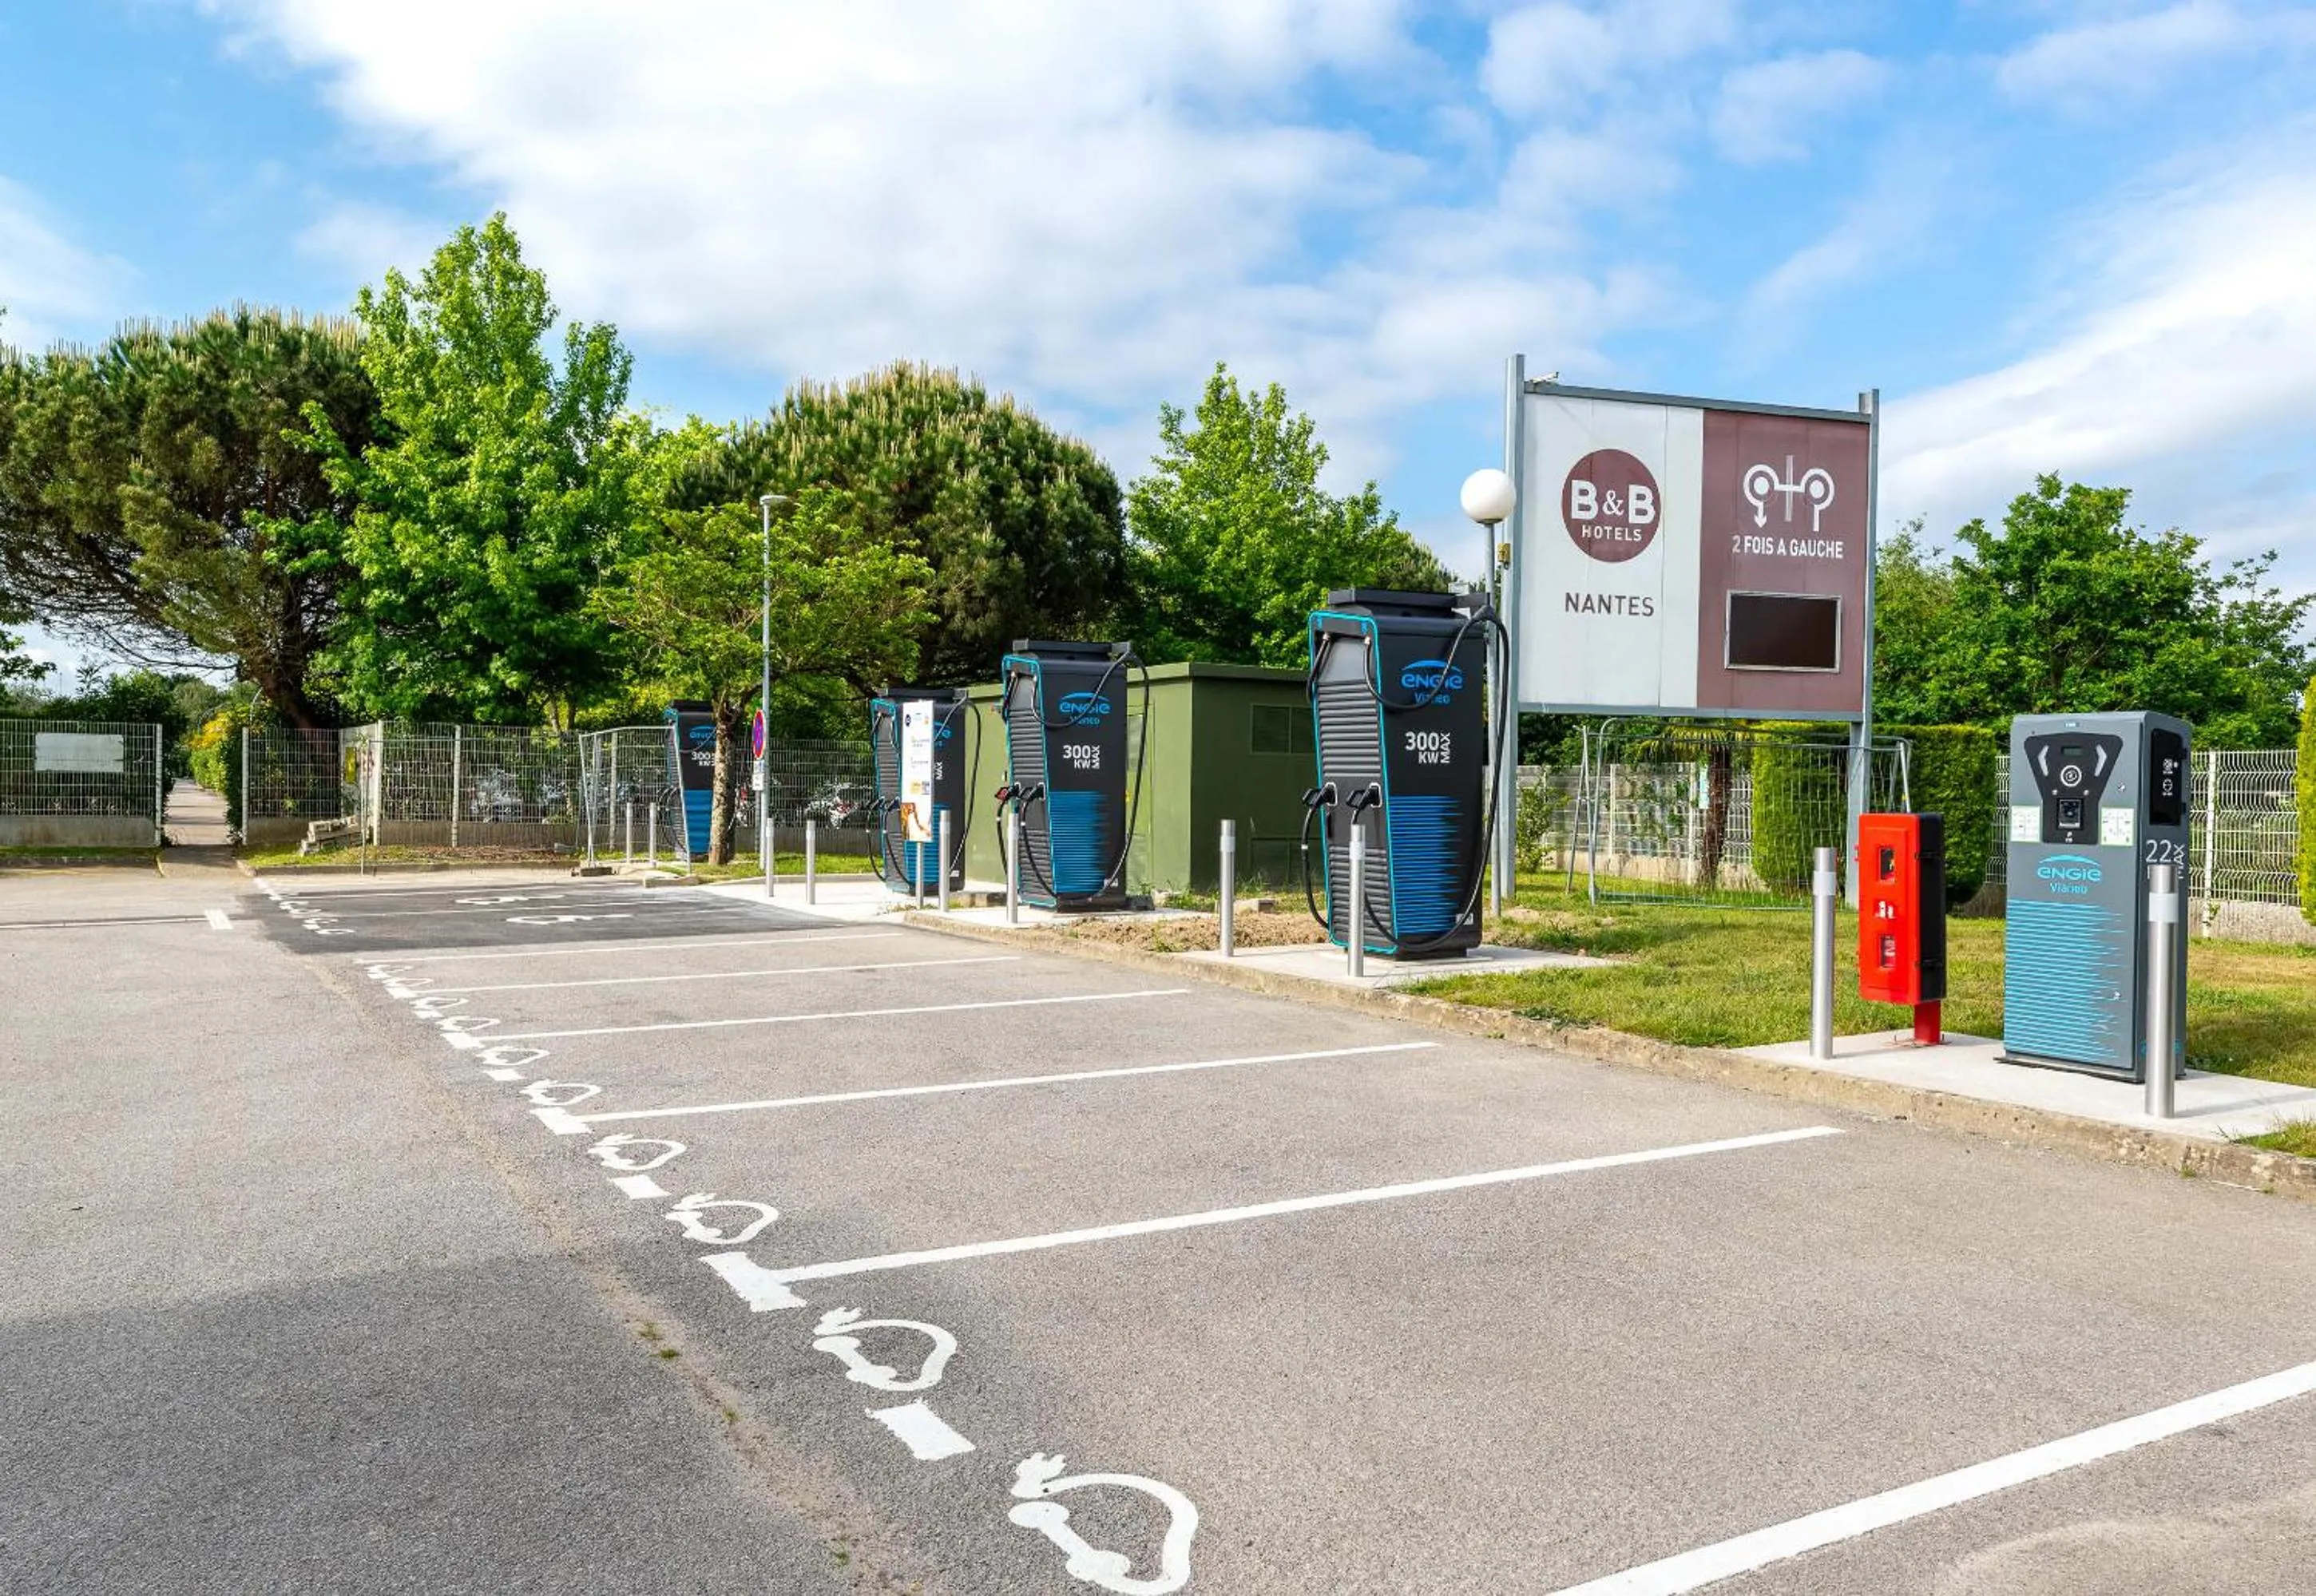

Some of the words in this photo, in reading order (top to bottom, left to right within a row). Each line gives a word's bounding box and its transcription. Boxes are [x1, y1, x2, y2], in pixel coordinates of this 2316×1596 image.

[1571, 479, 1656, 524] B&B
[1581, 525, 1642, 541] HOTELS
[1731, 535, 1741, 553] 2
[1743, 536, 1774, 555] FOIS
[1777, 537, 1787, 556] A
[1790, 538, 1844, 559] GAUCHE
[1565, 592, 1655, 616] NANTES
[1406, 731, 1439, 750] 300
[1440, 732, 1450, 763] MAX
[1063, 745, 1091, 759] 300
[1091, 745, 1100, 770] MAX
[1418, 751, 1439, 764] KW
[1074, 759, 1091, 770] KW
[2146, 840, 2171, 862] 22
